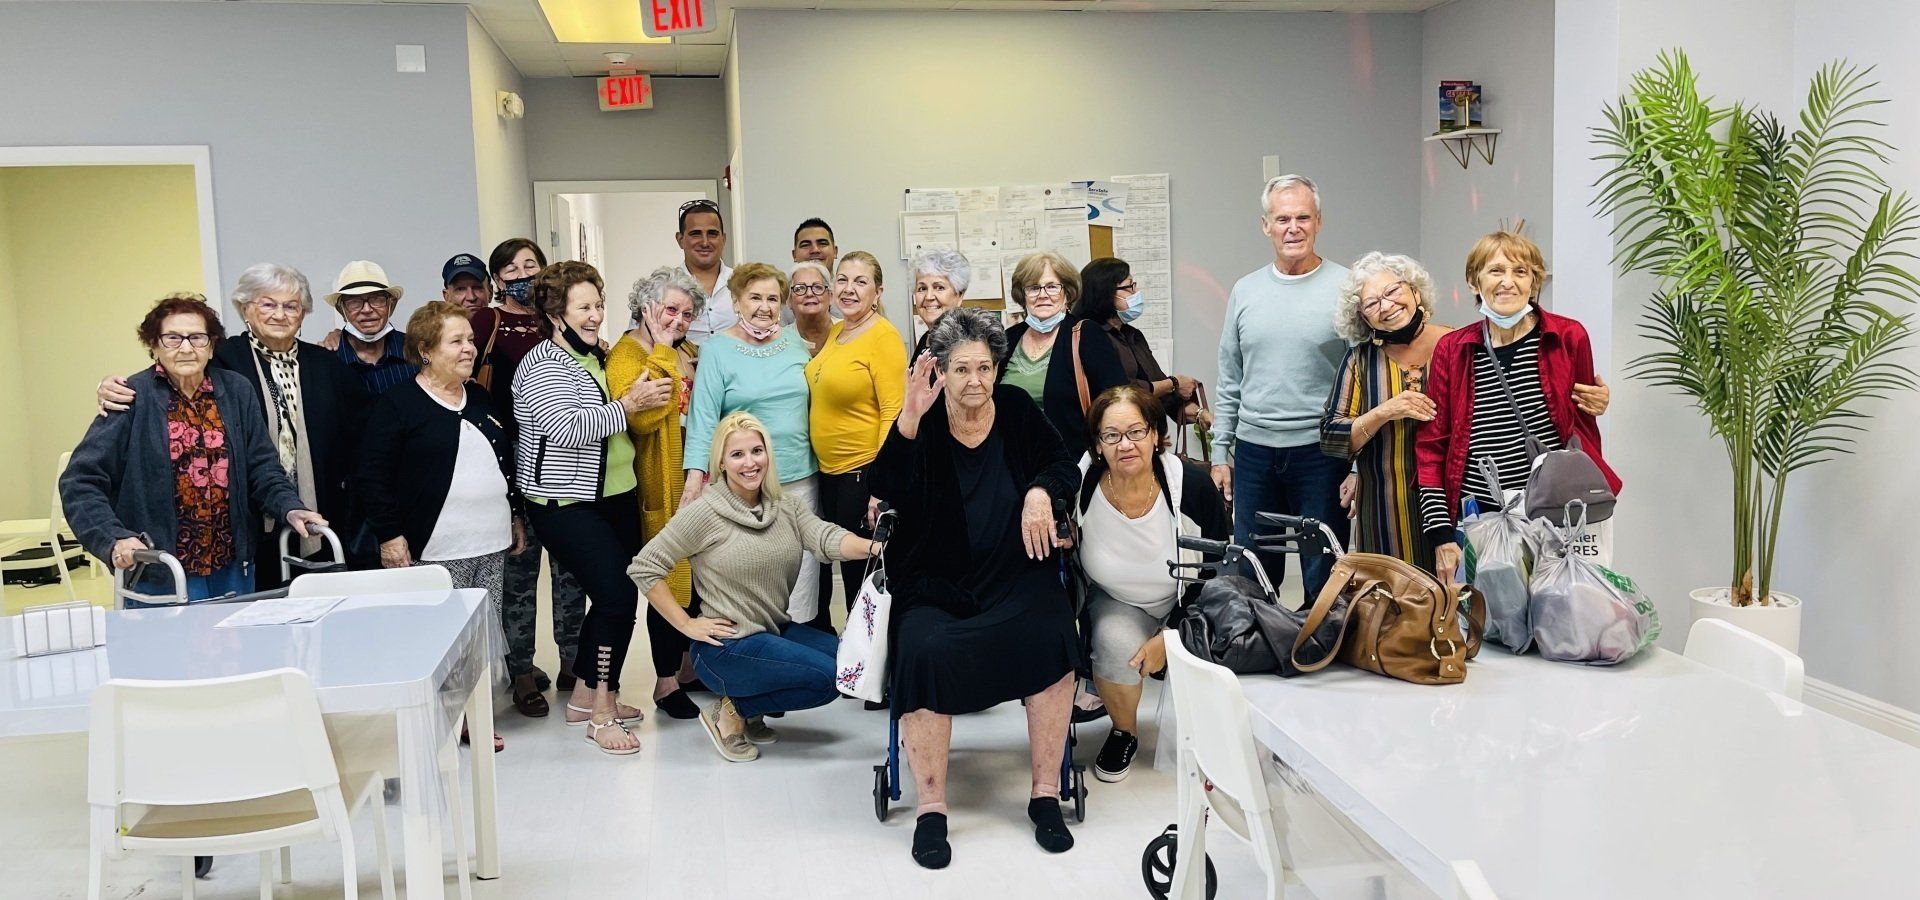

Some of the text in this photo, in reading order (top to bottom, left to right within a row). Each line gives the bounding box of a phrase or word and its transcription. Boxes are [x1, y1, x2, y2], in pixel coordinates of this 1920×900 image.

[652, 0, 703, 31] EXIT
[606, 76, 643, 106] EXIT
[1571, 545, 1599, 556] RES
